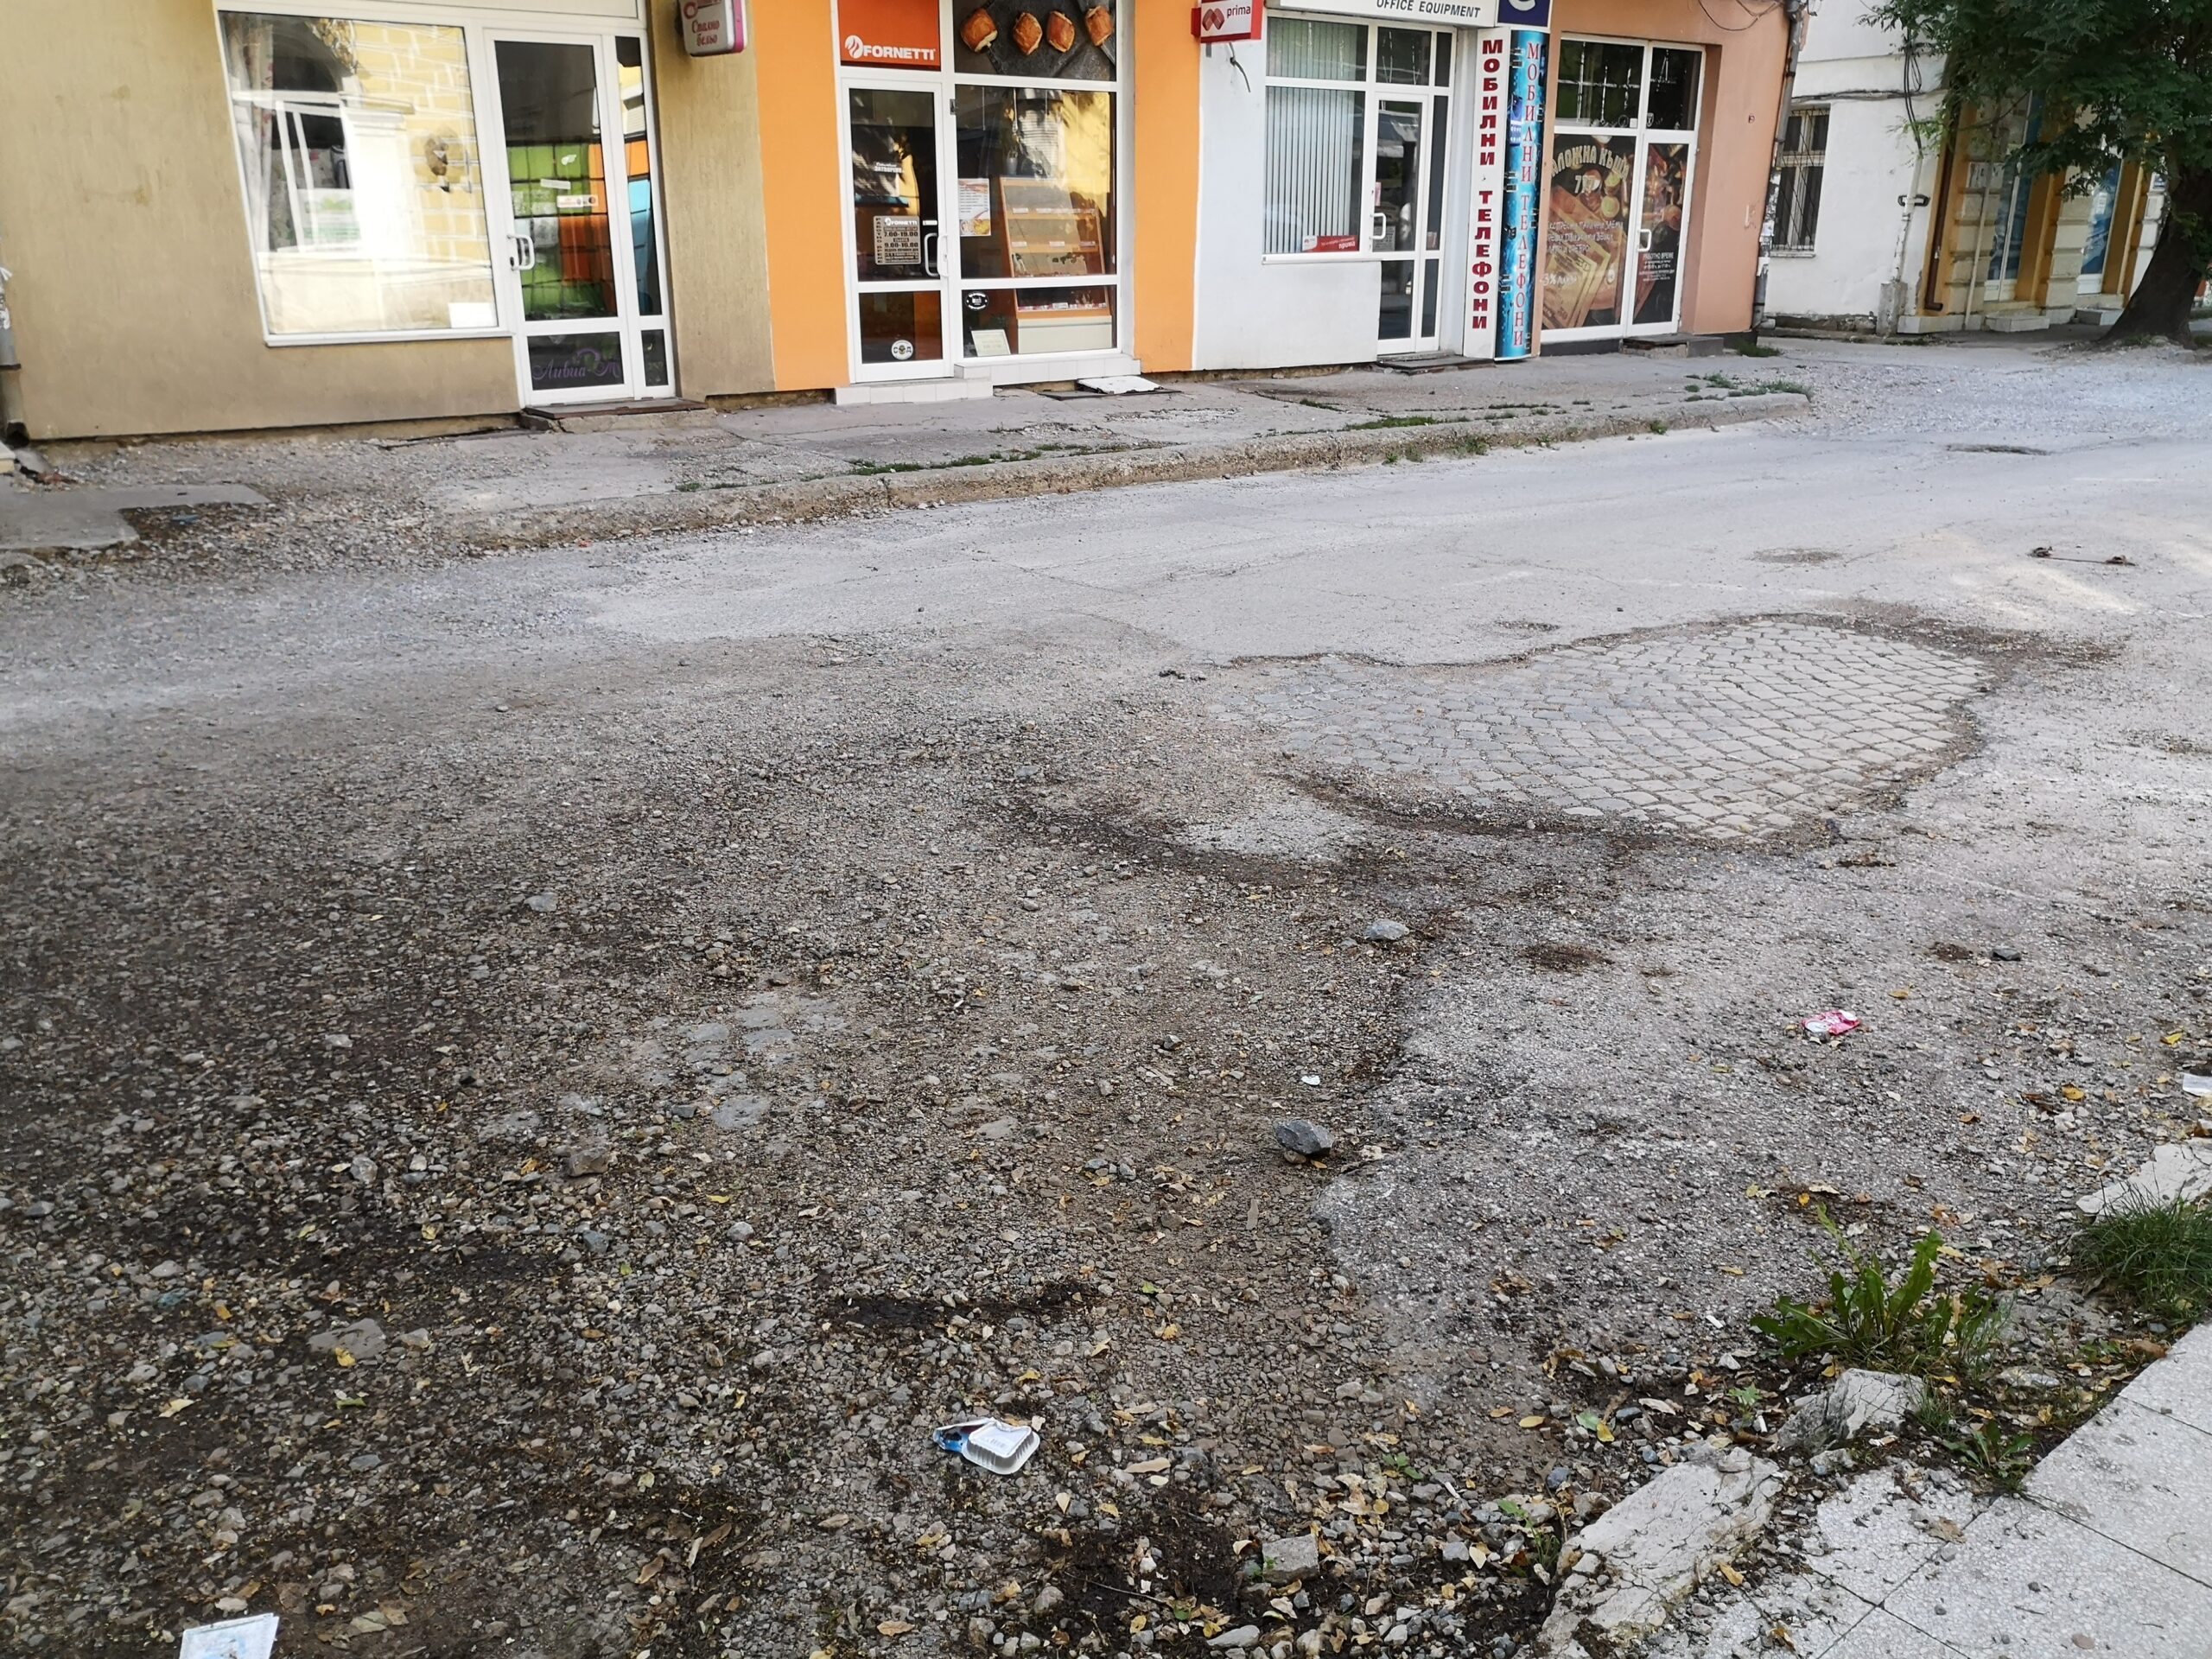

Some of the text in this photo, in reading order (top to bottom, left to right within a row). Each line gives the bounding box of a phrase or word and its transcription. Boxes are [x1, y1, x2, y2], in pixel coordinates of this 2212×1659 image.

[1227, 5, 1251, 18] prima
[1376, 0, 1481, 18] OFFICE EQUIPMENT
[863, 44, 935, 60] FORNETTI
[1471, 39, 1503, 329] МОБИЛНИ ТЕЛЕФОНИ
[1513, 41, 1539, 346] МОБИЛНИ ТЕЛЕФОНИ
